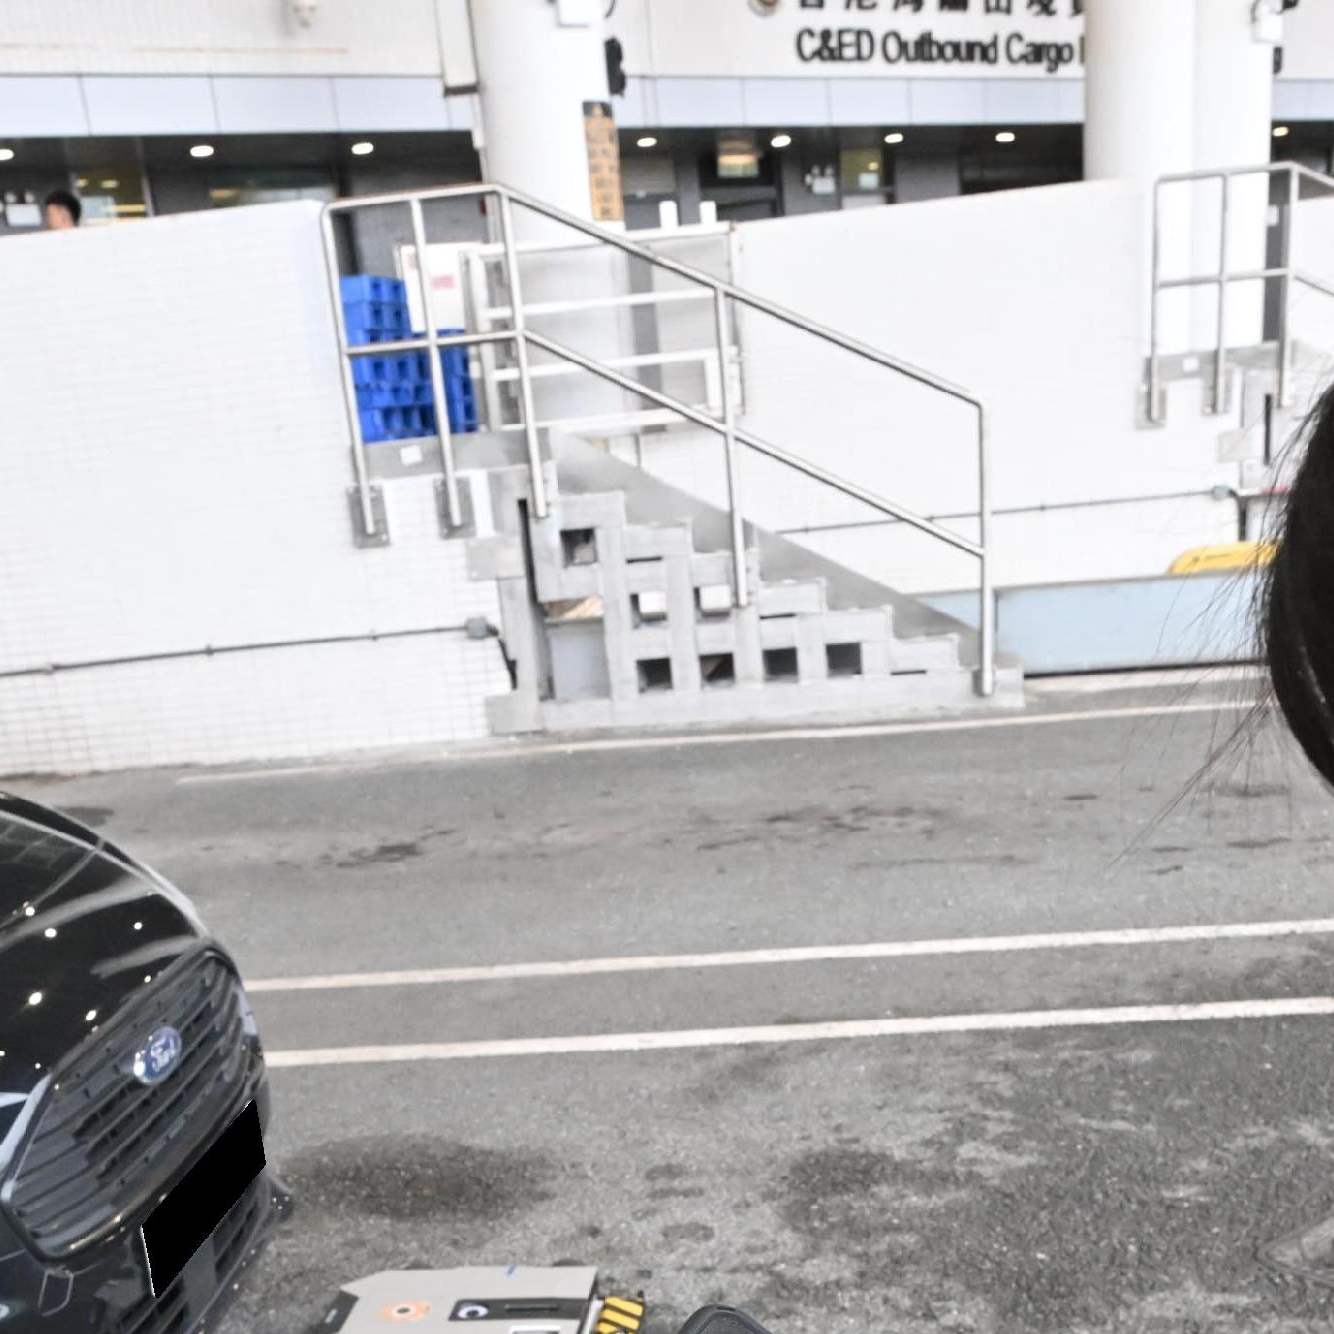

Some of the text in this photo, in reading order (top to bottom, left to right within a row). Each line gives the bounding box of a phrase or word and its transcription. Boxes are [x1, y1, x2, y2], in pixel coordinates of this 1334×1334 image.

[796, 27, 875, 62] C&ED
[881, 30, 999, 64] Outbound
[1005, 32, 1075, 73] Cargo
